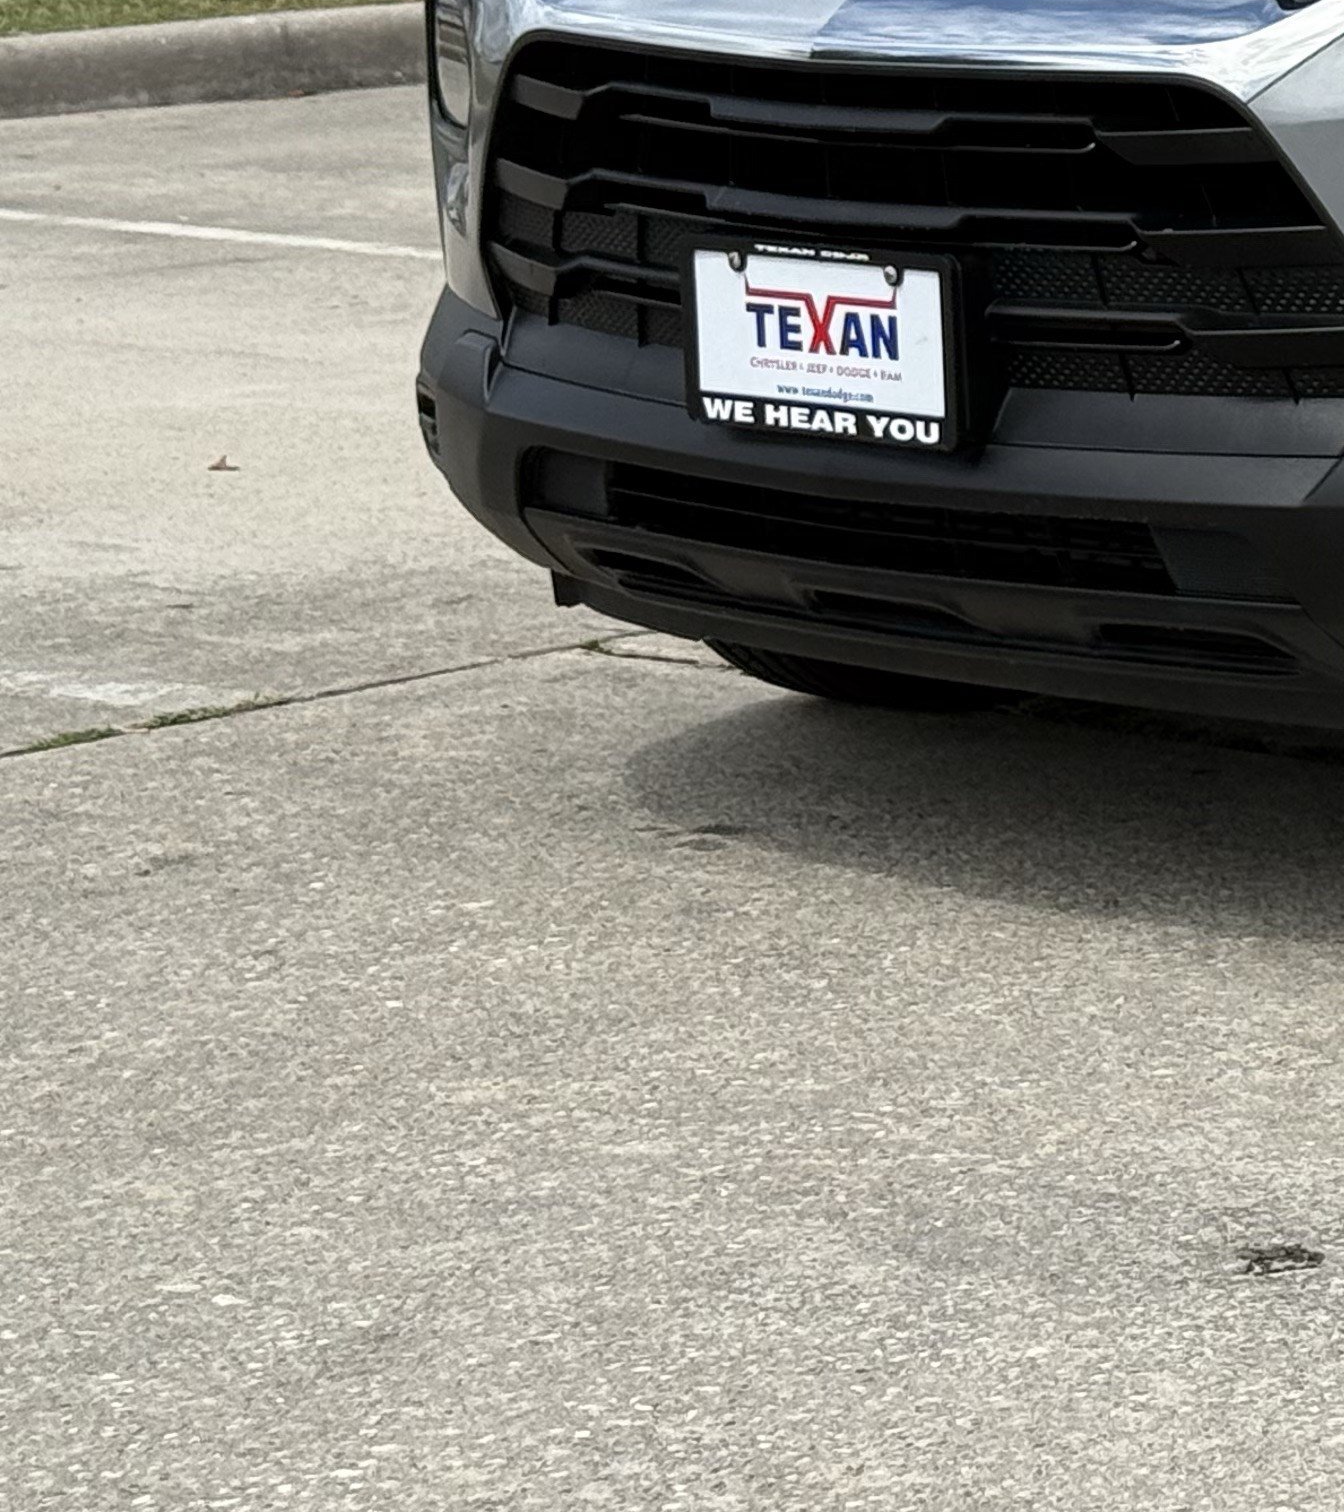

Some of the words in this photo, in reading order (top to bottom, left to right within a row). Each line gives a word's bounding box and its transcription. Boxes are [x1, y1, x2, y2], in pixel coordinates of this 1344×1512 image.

[745, 288, 900, 361] TEXAN
[837, 366, 871, 378] DODGE
[703, 397, 755, 424] WE
[765, 404, 857, 435] HEAR
[866, 415, 940, 445] YOU
